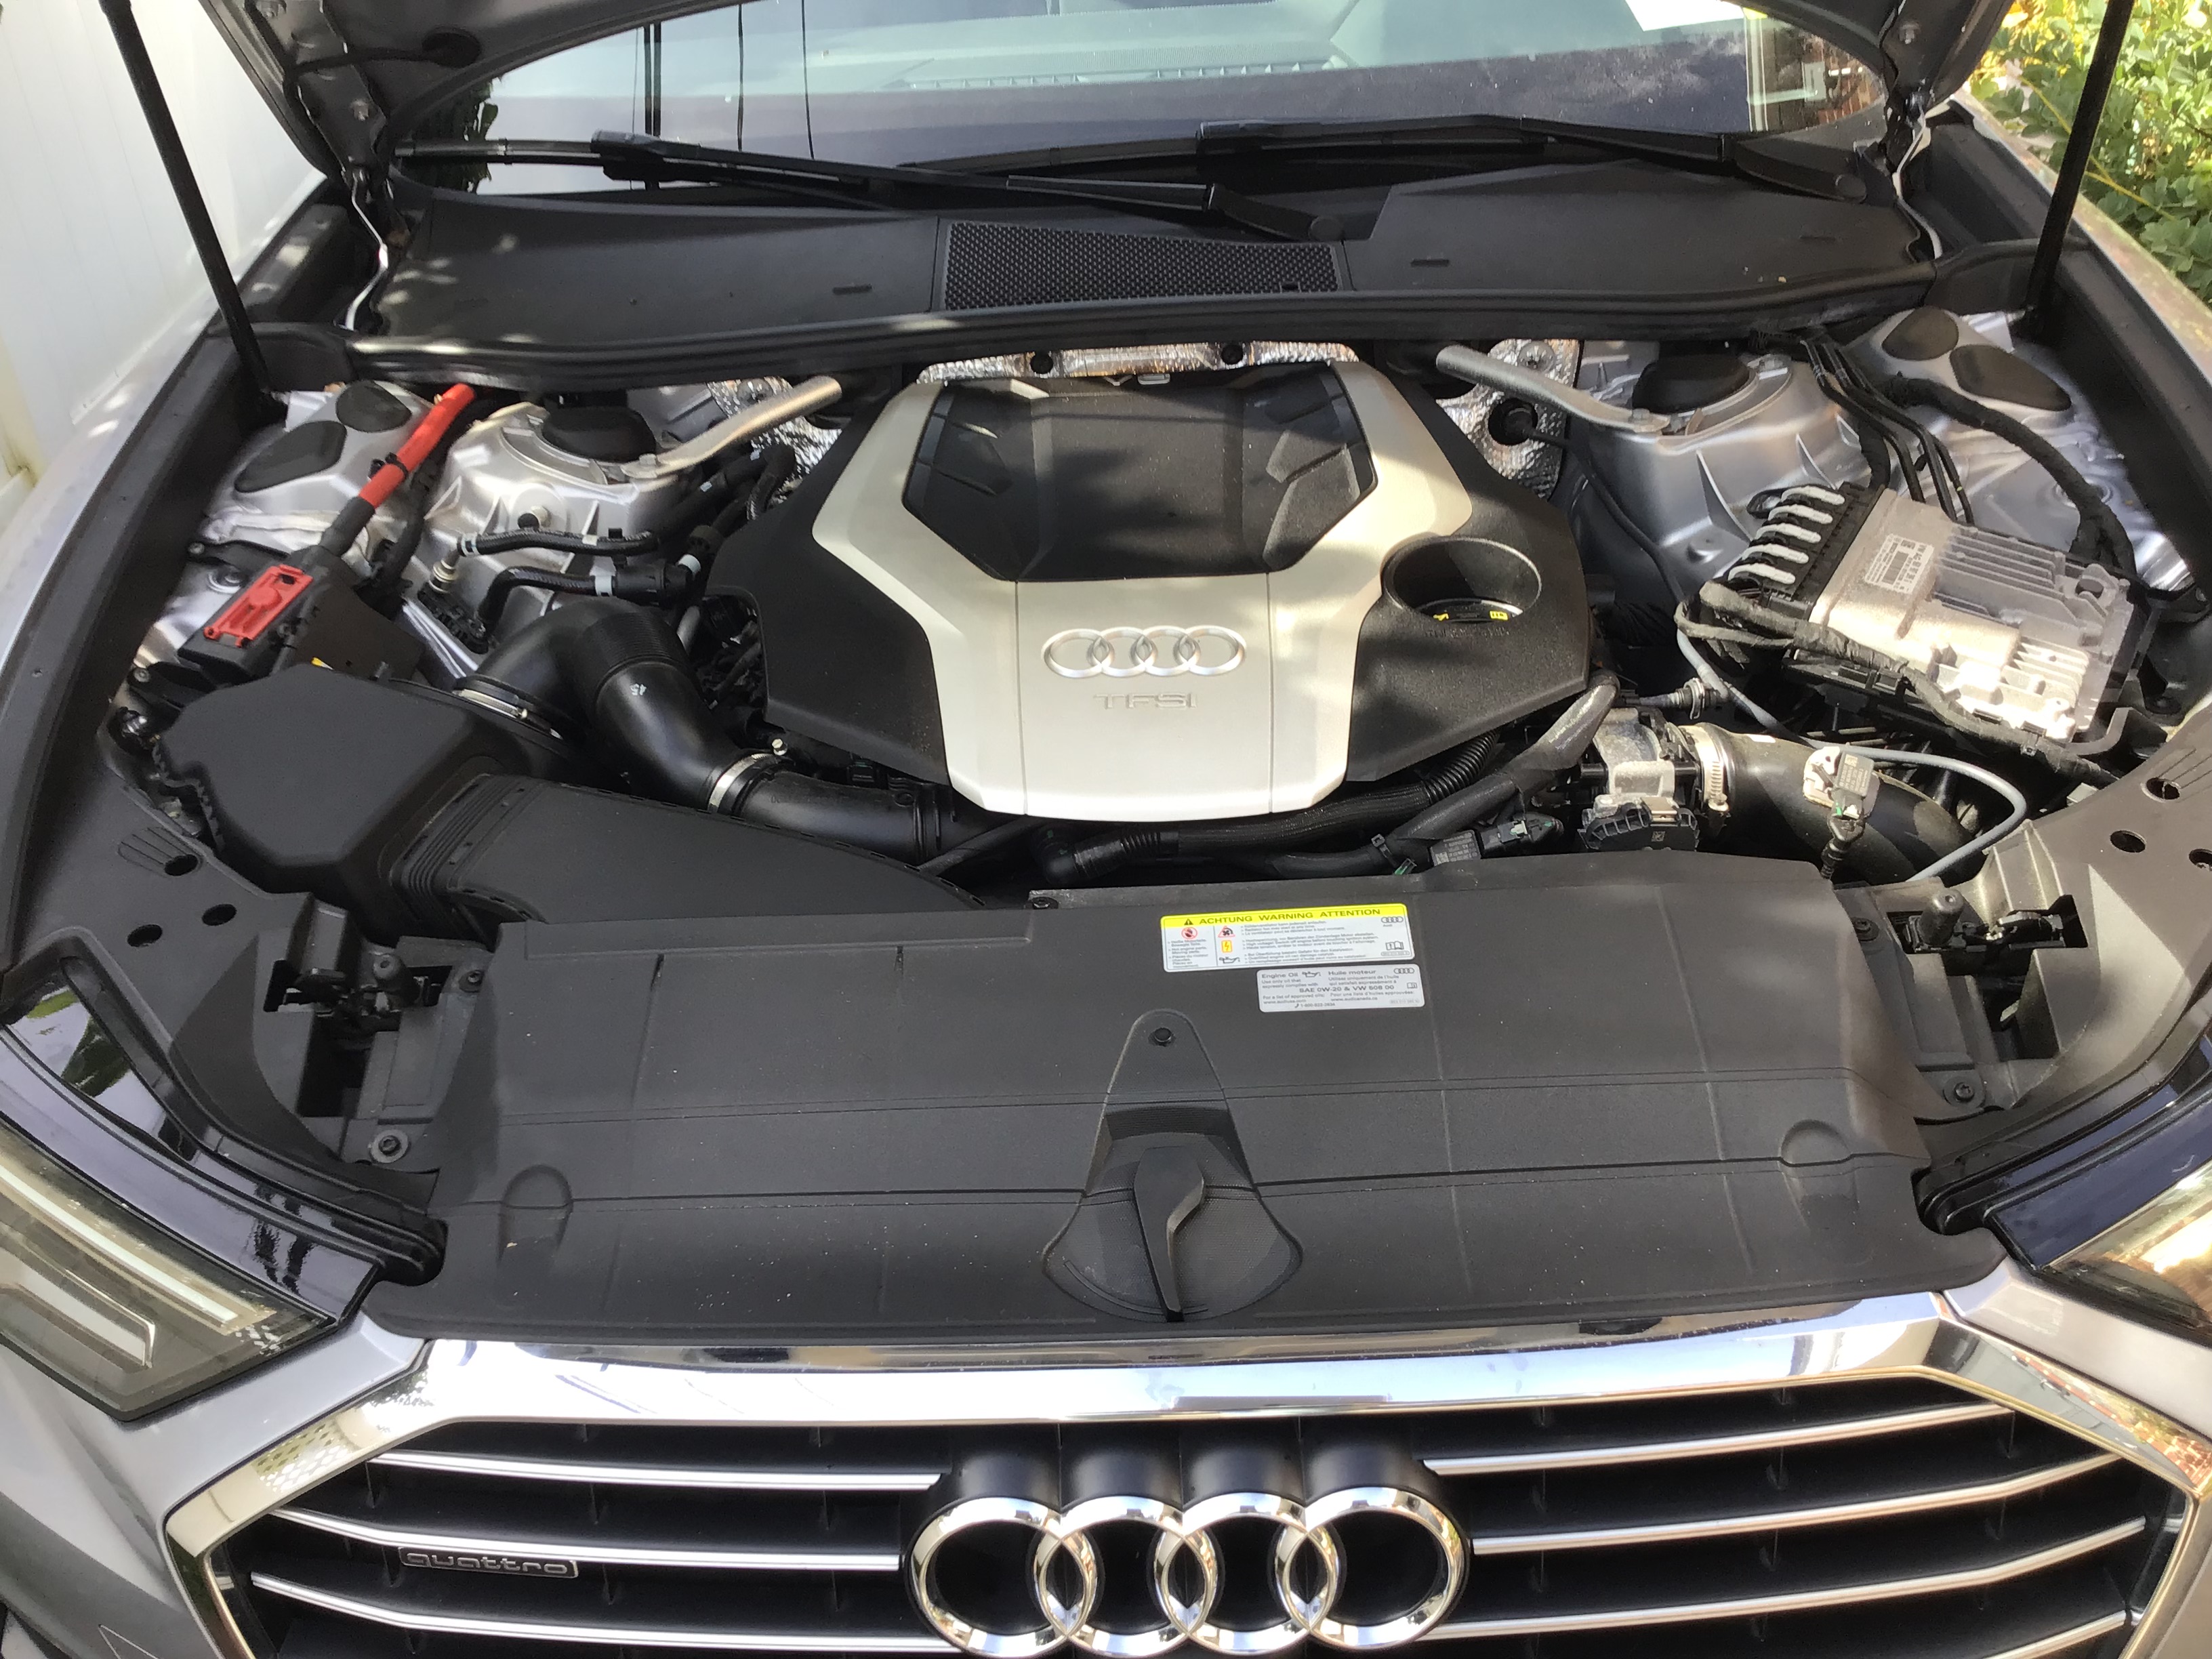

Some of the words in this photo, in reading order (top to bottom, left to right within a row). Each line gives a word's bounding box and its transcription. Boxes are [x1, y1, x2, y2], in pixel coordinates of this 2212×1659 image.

[1093, 693, 1197, 710] TFSI
[1199, 916, 1252, 924] ACHTUNG
[1258, 912, 1313, 921] WARNING
[1320, 909, 1380, 917] ATTENTION
[407, 1553, 568, 1574] quattro
